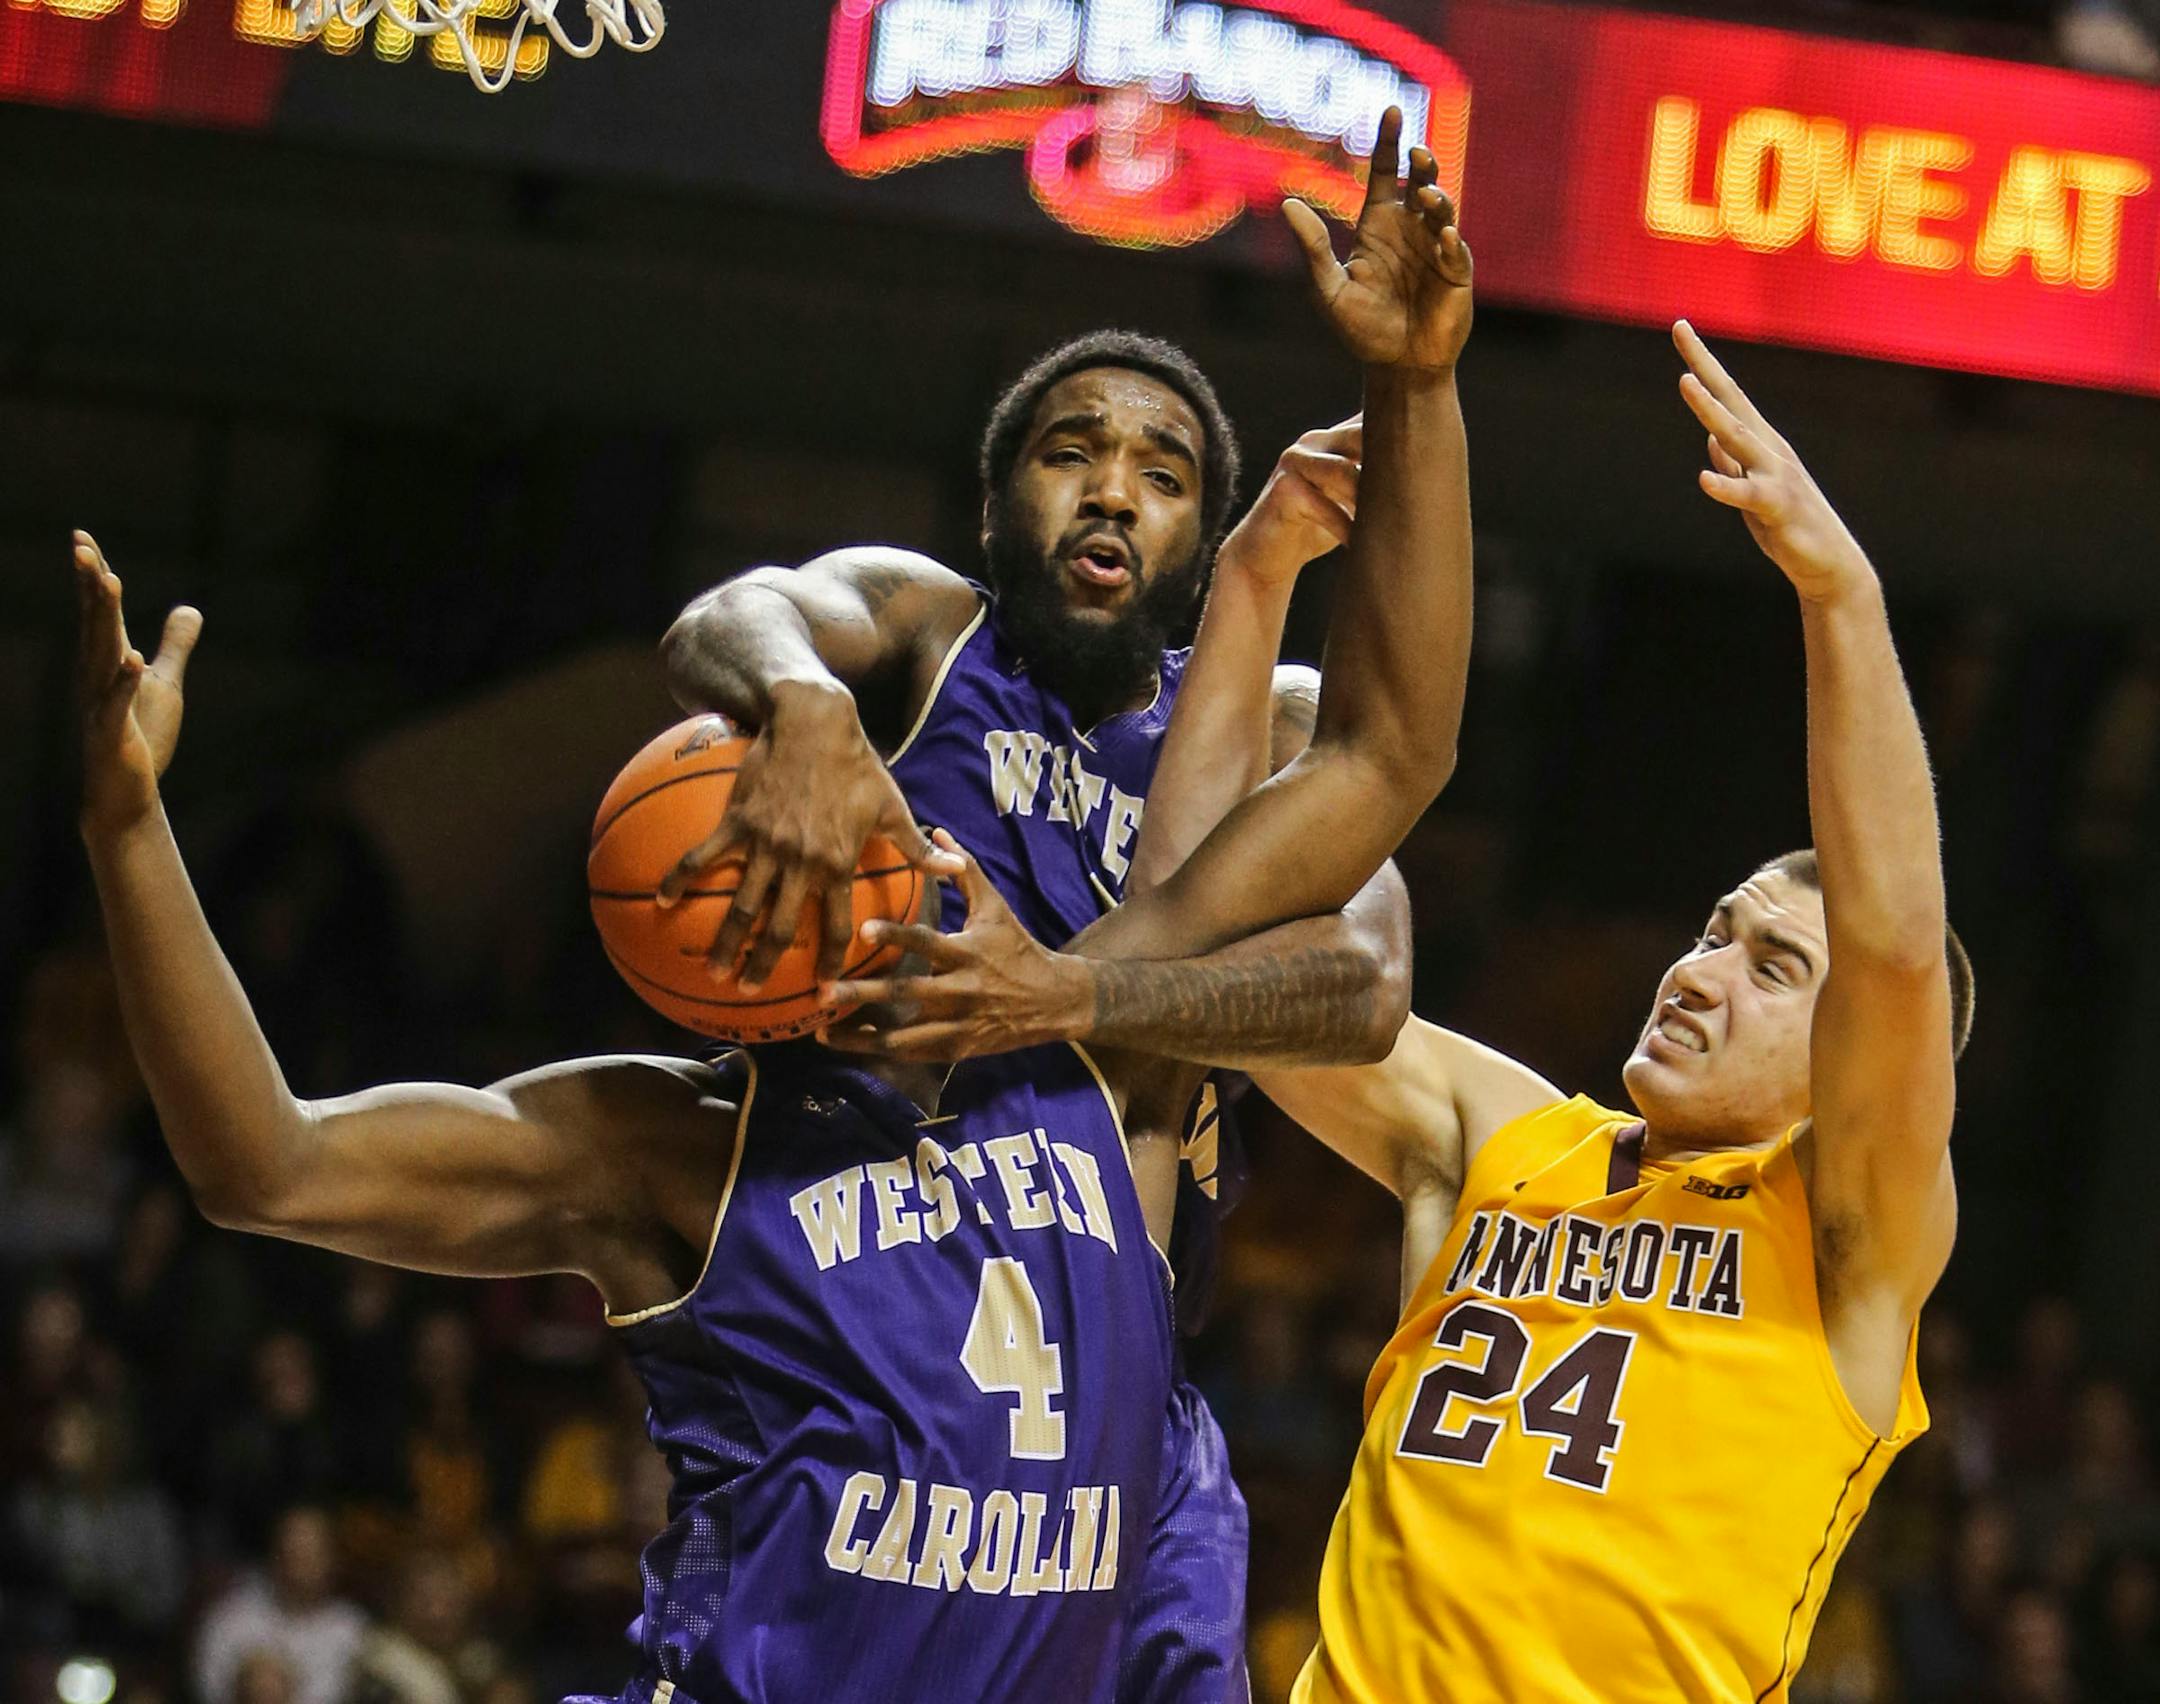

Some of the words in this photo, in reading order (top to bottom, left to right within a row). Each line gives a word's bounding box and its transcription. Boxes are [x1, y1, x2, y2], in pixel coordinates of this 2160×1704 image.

[1643, 94, 1975, 272] LOVE
[1970, 144, 2152, 296] AT
[959, 1256, 1066, 1460] 4
[1443, 1210, 1744, 1319] MNNESOTA
[1395, 1300, 1638, 1494] 24
